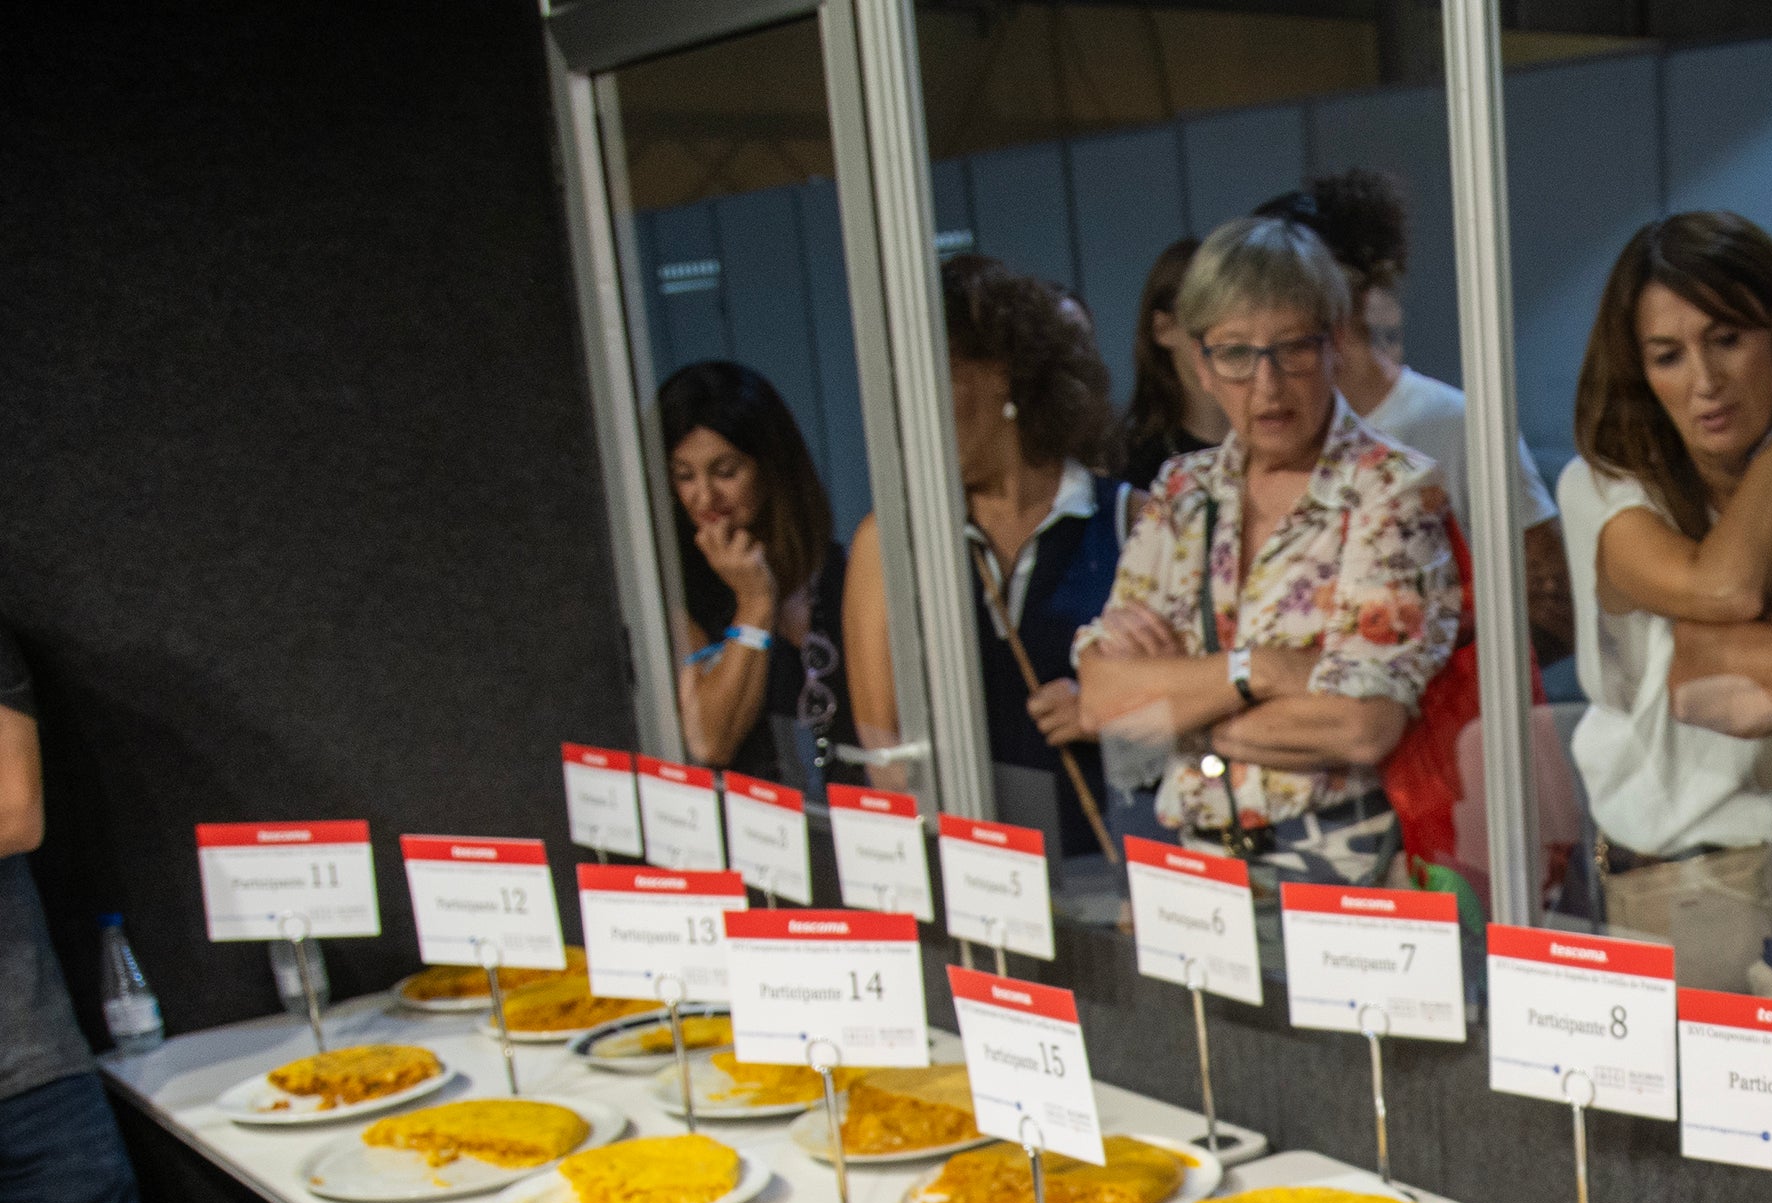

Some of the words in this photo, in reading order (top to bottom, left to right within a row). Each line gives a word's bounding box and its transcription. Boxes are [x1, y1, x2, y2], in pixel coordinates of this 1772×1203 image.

[311, 862, 338, 889] 11
[1010, 871, 1022, 897] 5
[500, 886, 528, 915] 12
[686, 916, 718, 946] 13
[1212, 907, 1225, 936] 6
[1400, 943, 1417, 973] 7
[848, 970, 884, 1001] 14
[1528, 1008, 1606, 1037] Participante
[1610, 1005, 1628, 1039] 8
[1039, 1041, 1066, 1078] 15
